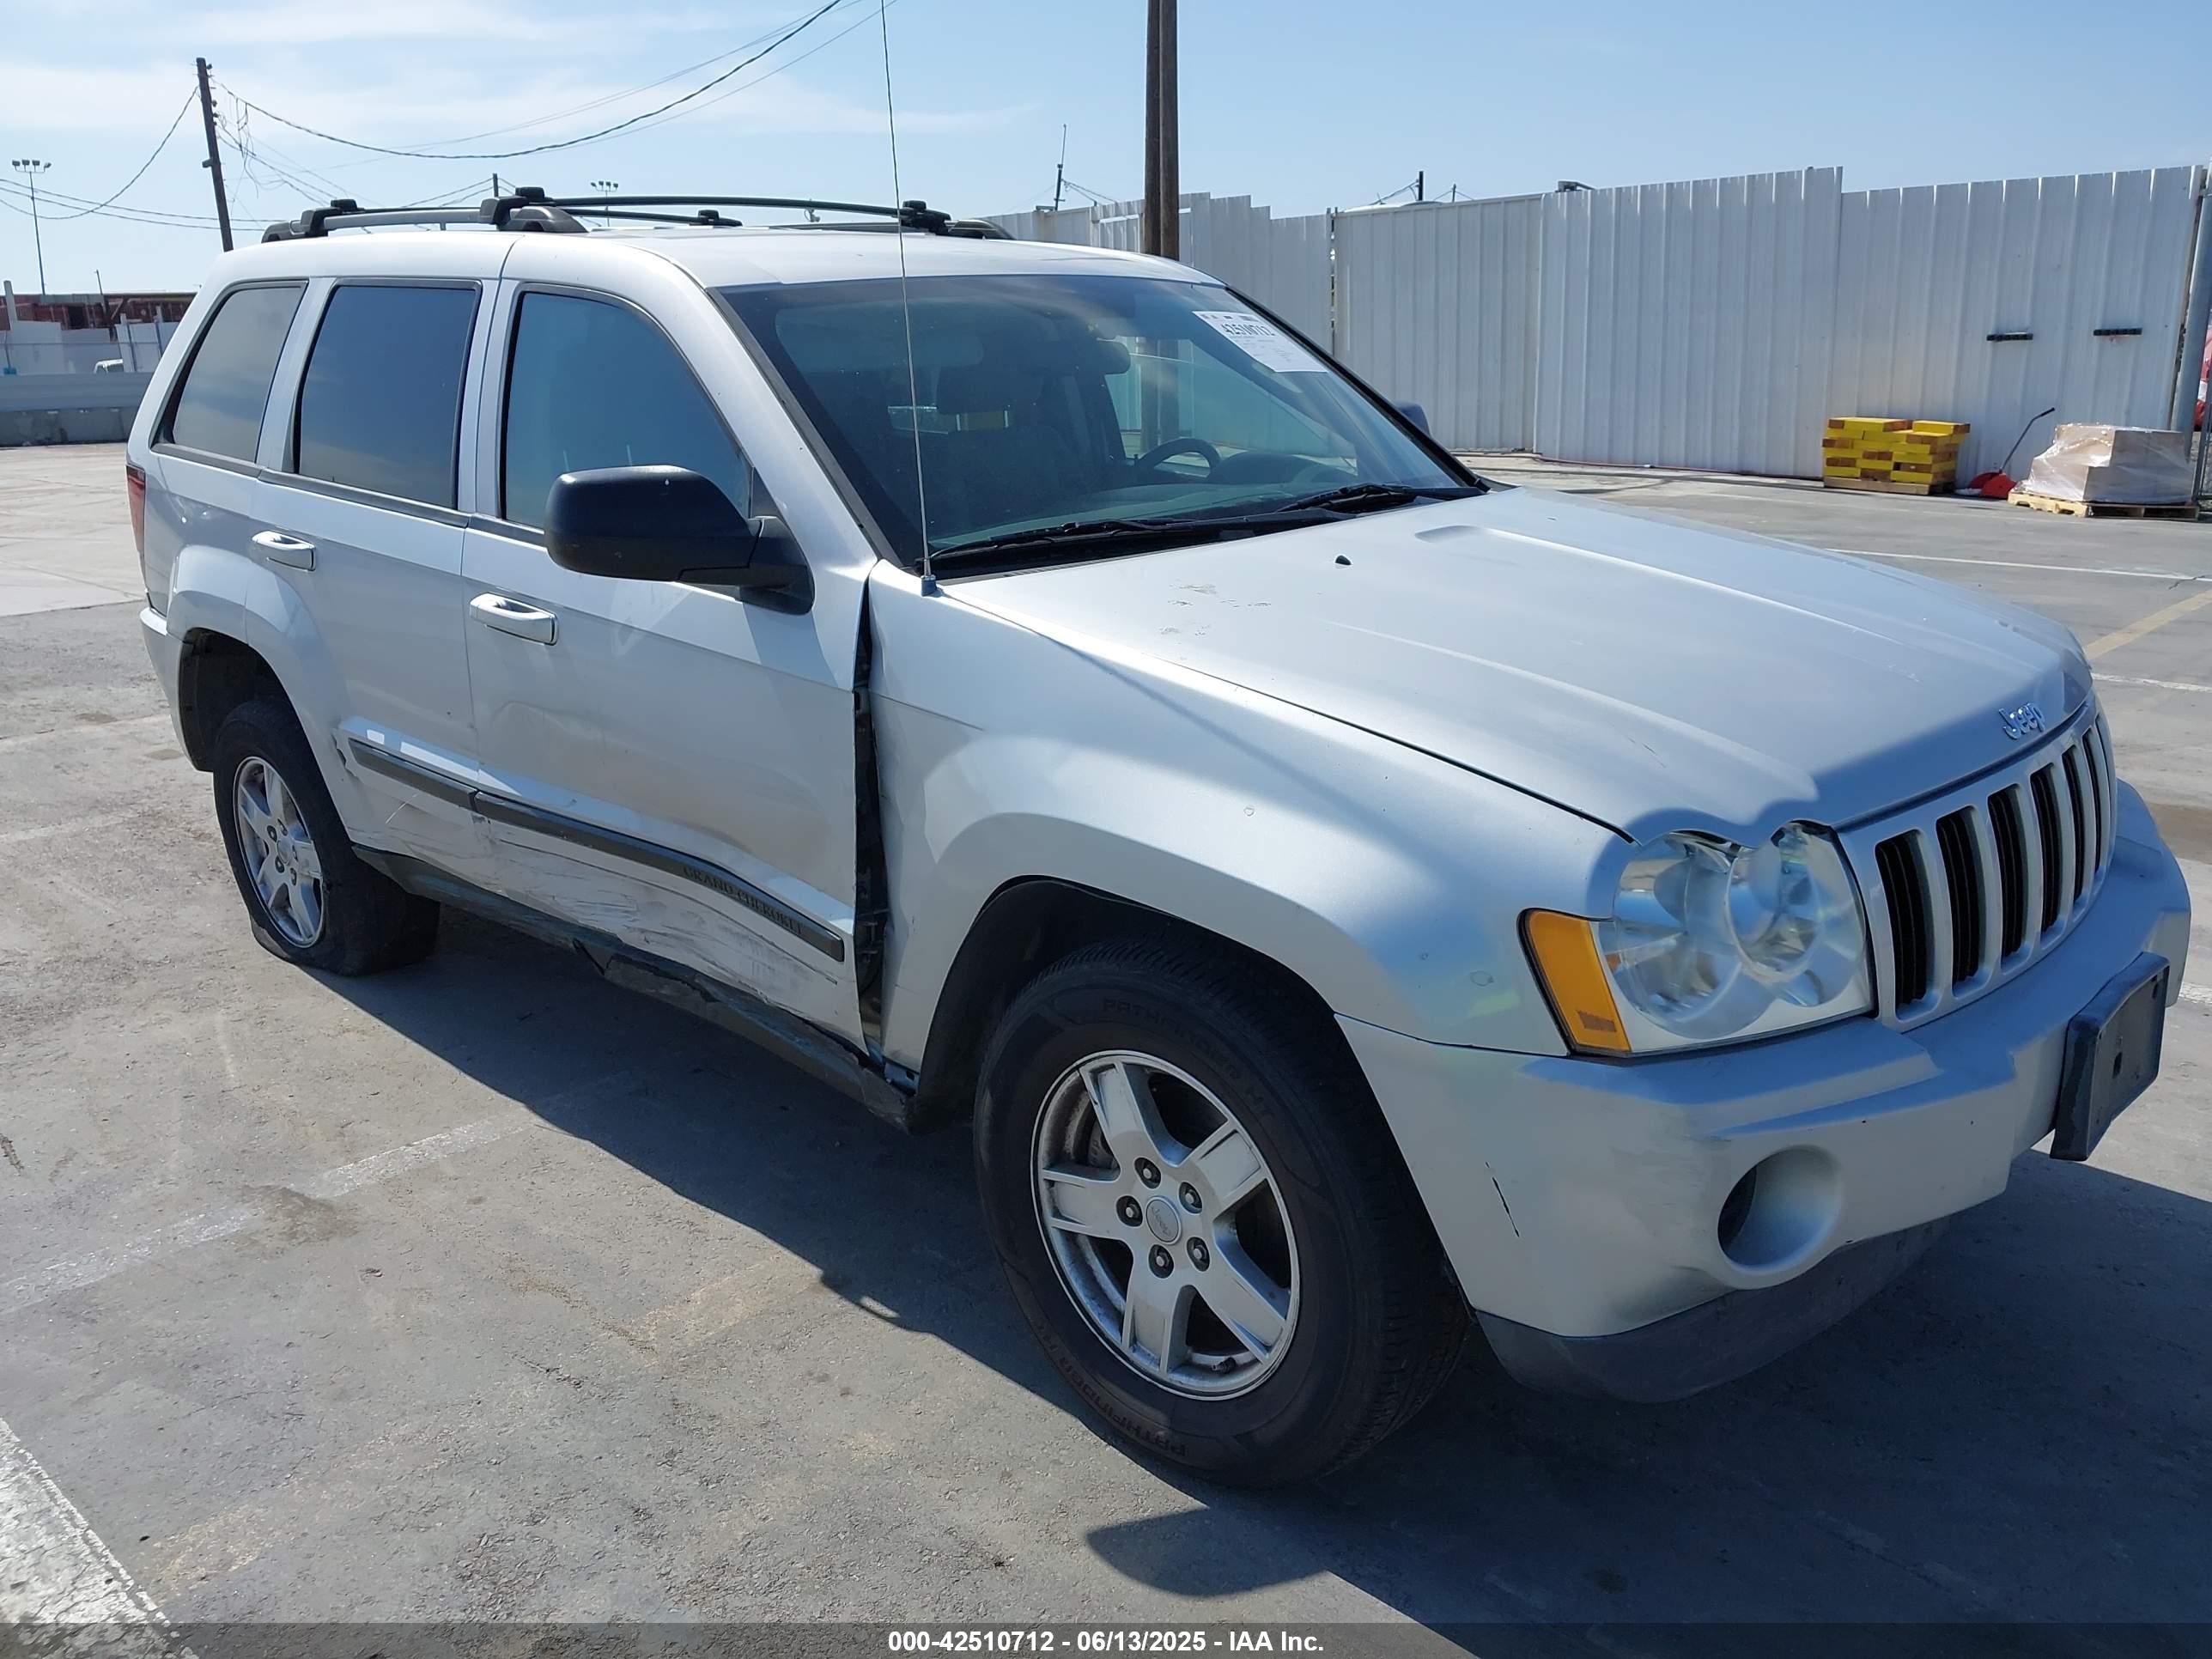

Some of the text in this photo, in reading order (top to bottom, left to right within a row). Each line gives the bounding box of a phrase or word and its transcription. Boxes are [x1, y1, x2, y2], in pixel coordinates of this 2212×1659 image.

[1221, 324, 1275, 336] 42510712
[1998, 702, 2045, 740] Jeep
[683, 866, 804, 935] GRAND CHEROKEE
